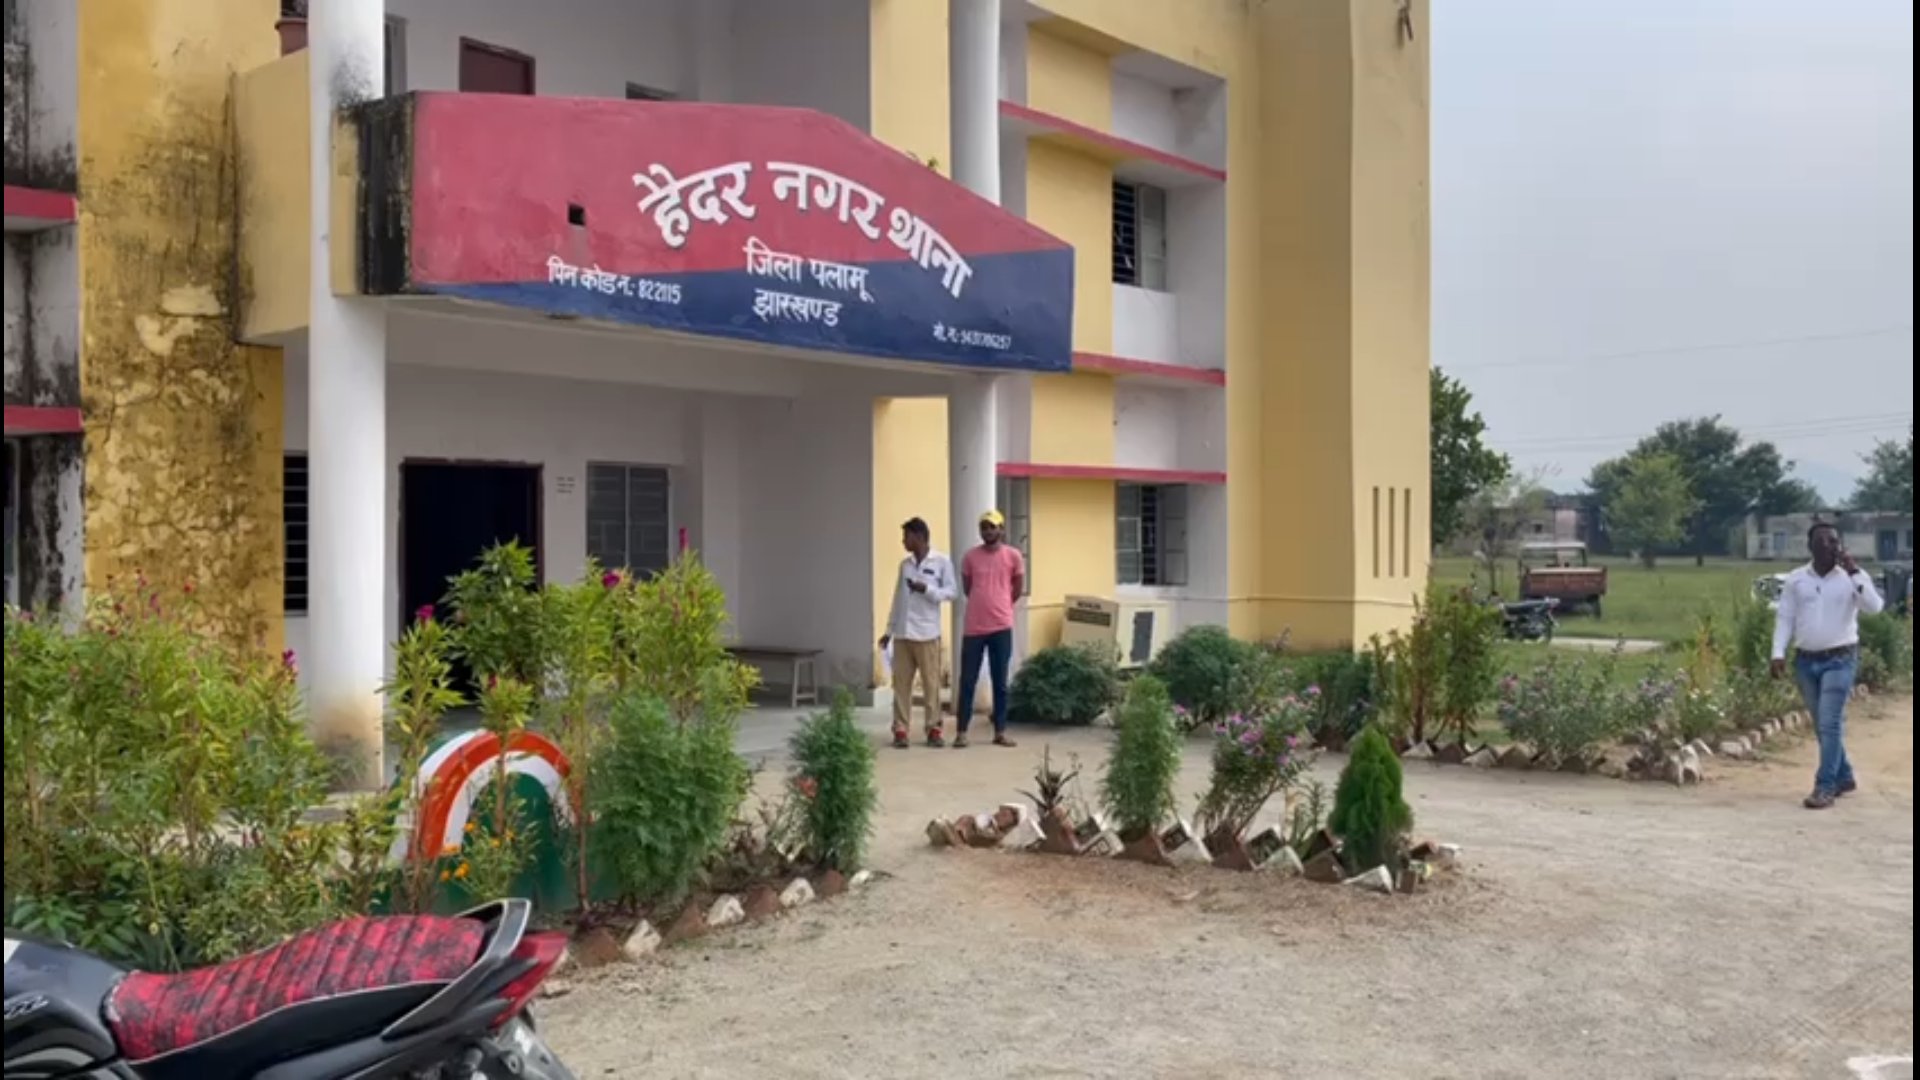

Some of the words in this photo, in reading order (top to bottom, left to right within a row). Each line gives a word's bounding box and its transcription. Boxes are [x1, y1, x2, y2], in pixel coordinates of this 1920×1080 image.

[633, 161, 756, 247] हैदर
[767, 161, 885, 239] नगर
[887, 206, 973, 298] थाना
[546, 255, 578, 287] पिन
[580, 263, 617, 295] कोड
[742, 235, 803, 284] जिला
[808, 258, 875, 303] पलामू
[752, 287, 843, 327] झारखण्ड
